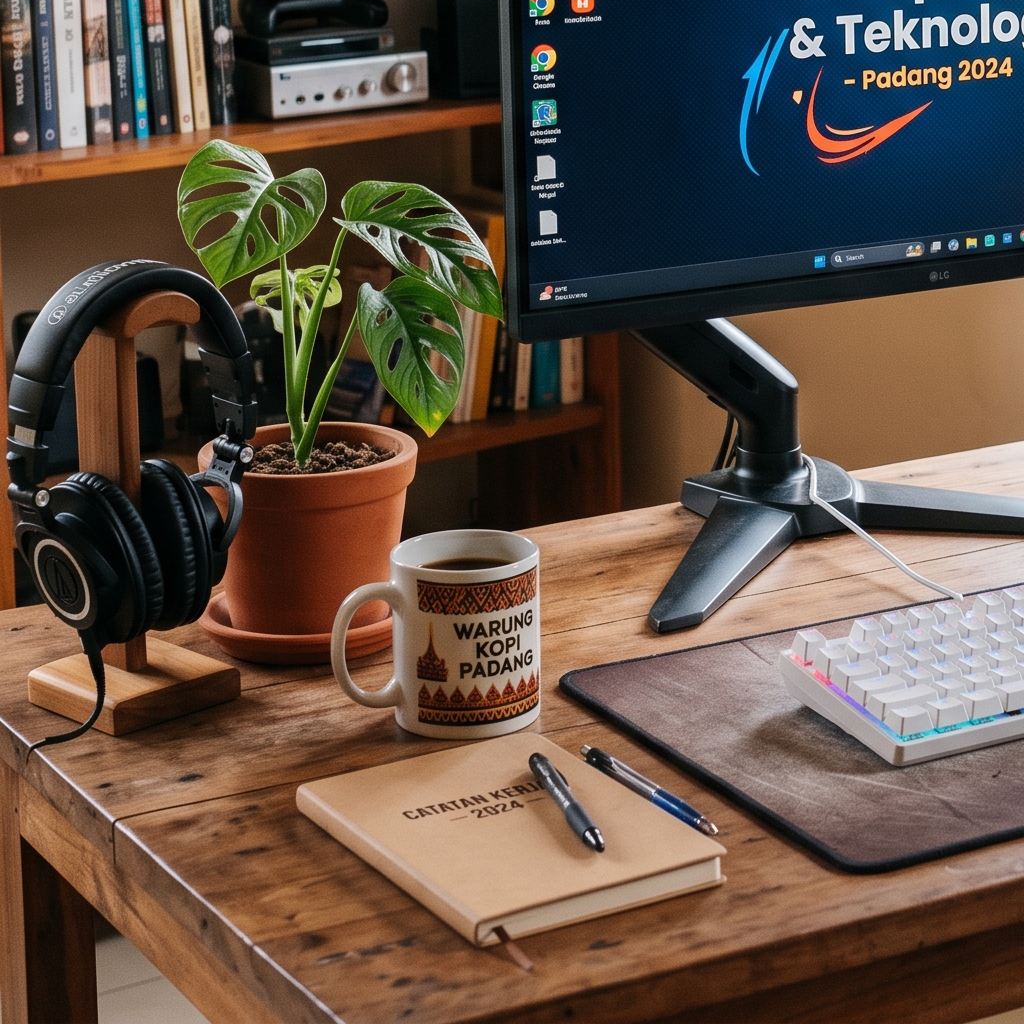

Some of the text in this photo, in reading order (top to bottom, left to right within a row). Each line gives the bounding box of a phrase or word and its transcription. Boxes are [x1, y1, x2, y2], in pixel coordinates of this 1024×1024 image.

[789, 17, 826, 59] &
[862, 65, 953, 90] Padang
[957, 56, 1014, 82] 2024
[939, 271, 950, 280] LG
[453, 609, 533, 640] WARUNG
[475, 634, 520, 659] KOPI
[459, 649, 533, 679] PADANG
[402, 794, 489, 820] CATATAN
[470, 800, 525, 819] 2024
